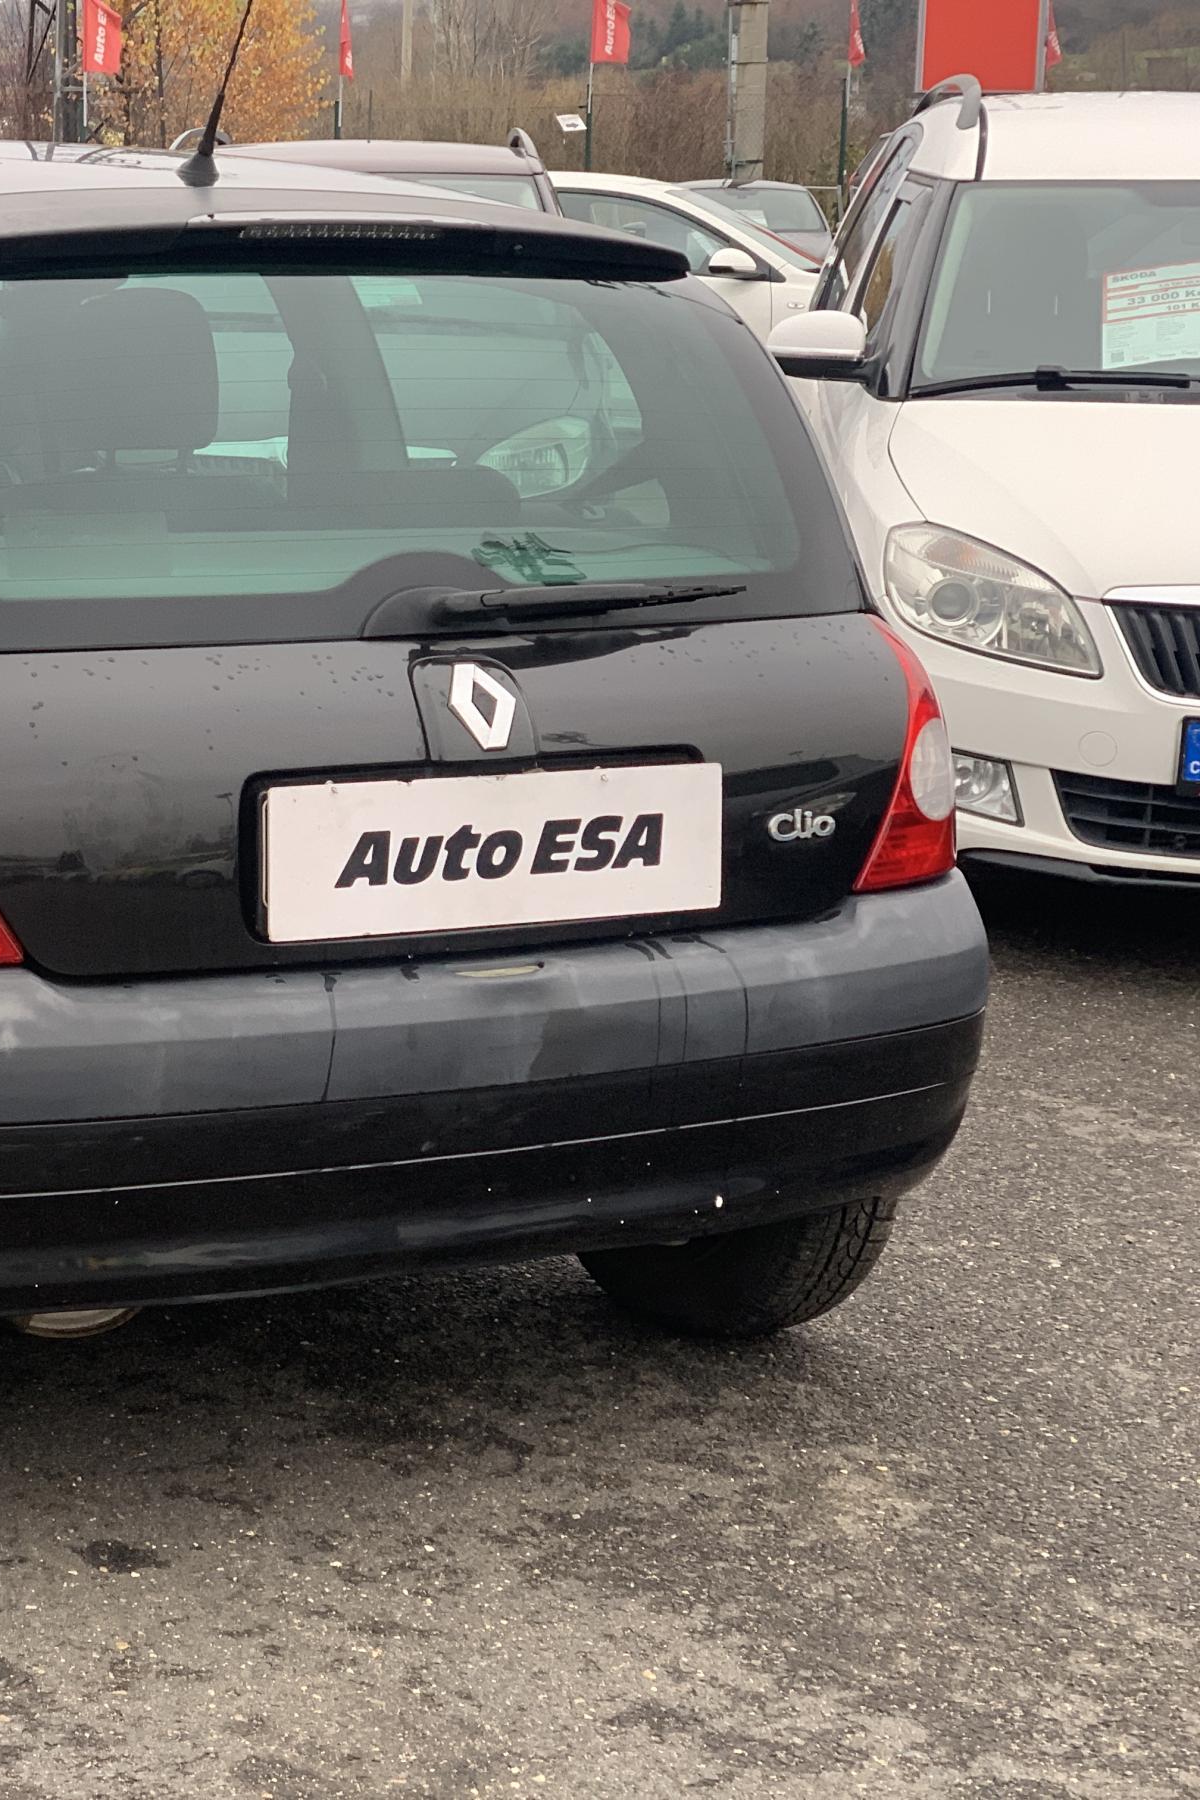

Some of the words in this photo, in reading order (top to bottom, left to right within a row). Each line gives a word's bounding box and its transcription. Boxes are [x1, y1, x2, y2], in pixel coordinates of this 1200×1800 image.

[606, 0, 616, 20] ES
[93, 26, 106, 65] Auto
[604, 20, 616, 56] Auto
[1127, 296, 1146, 306] 33
[1151, 291, 1180, 302] 000
[1166, 303, 1186, 311] 101
[1190, 760, 1200, 774] C
[767, 808, 836, 842] Clio
[334, 824, 523, 889] Auto
[530, 812, 663, 875] ESA
